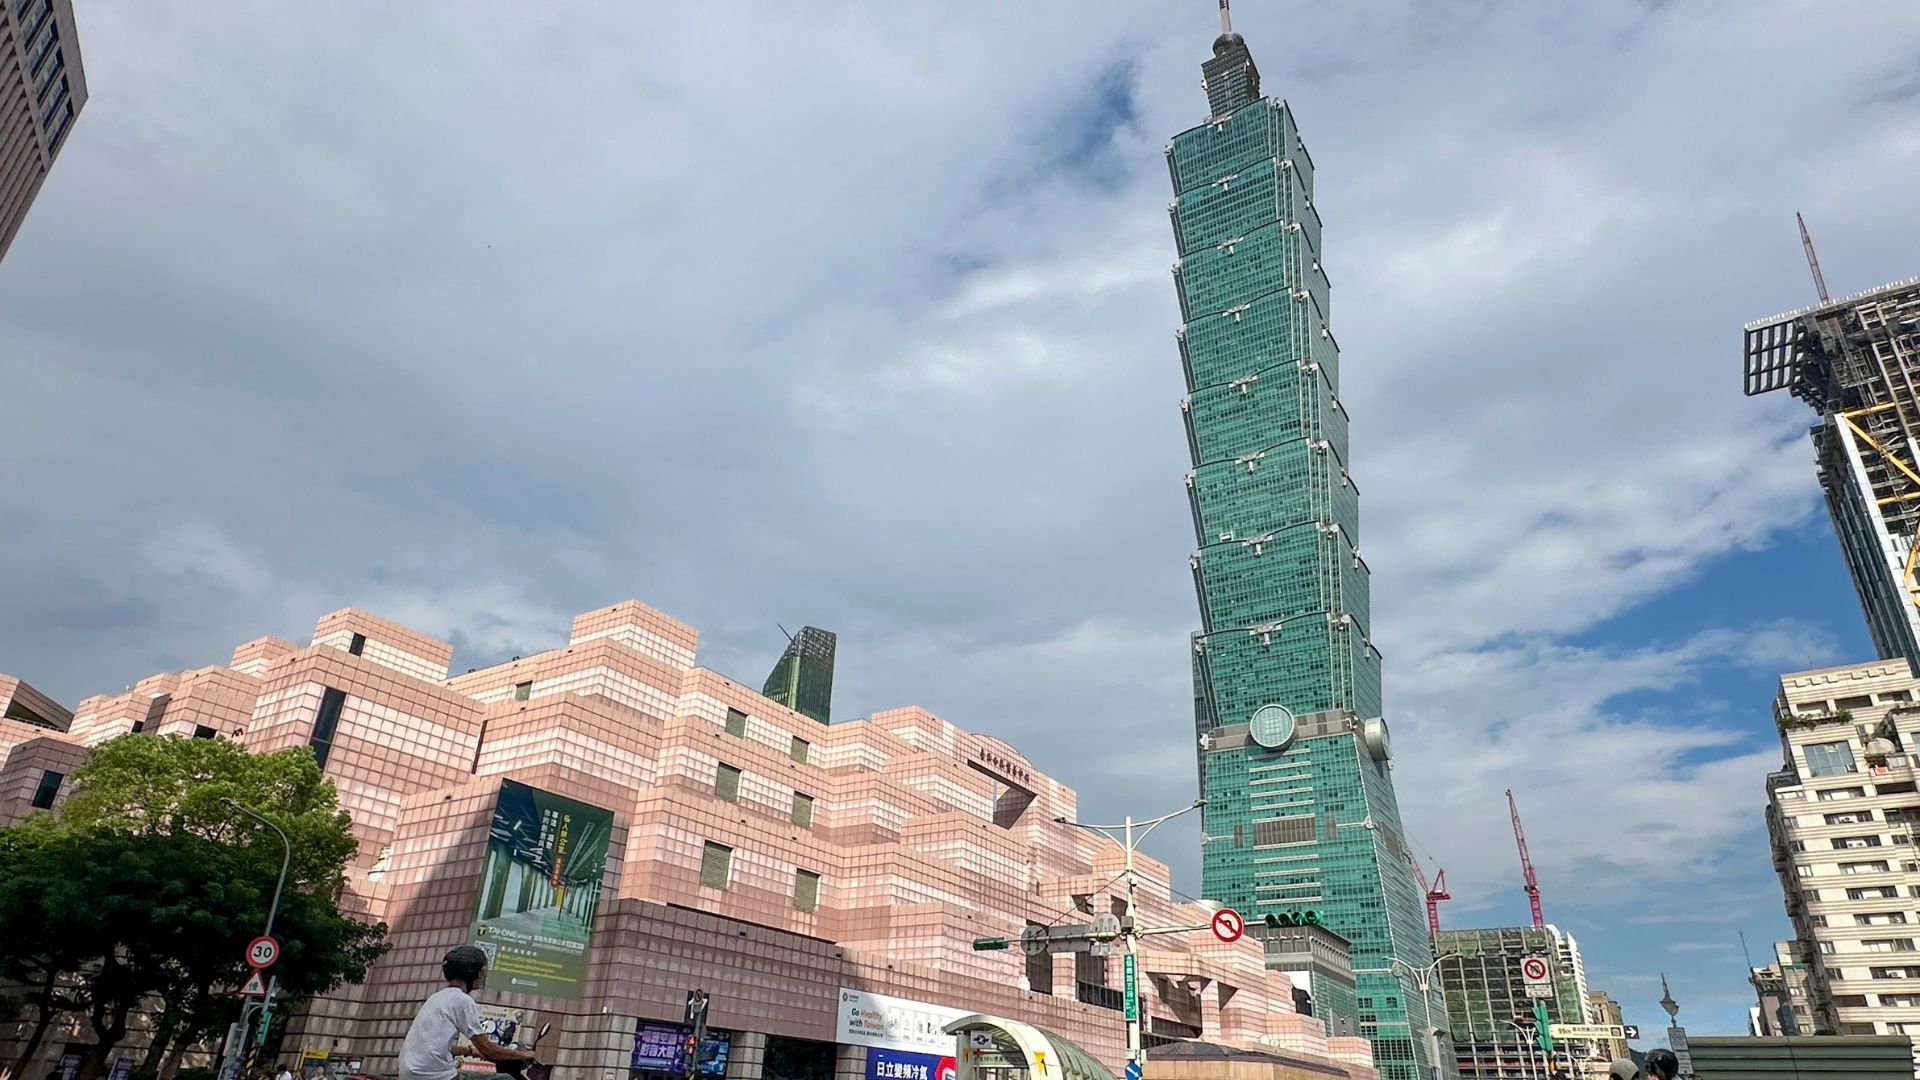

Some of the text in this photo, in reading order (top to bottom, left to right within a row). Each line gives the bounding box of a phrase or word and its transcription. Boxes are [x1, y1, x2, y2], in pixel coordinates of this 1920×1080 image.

[253, 946, 272, 958] 30
[249, 982, 258, 991] 慢
[851, 1008, 860, 1017] Go
[849, 1017, 884, 1031] with Taiwan
[640, 1044, 675, 1058] 影音大展
[876, 1061, 928, 1080] 日立變頻冷氣
